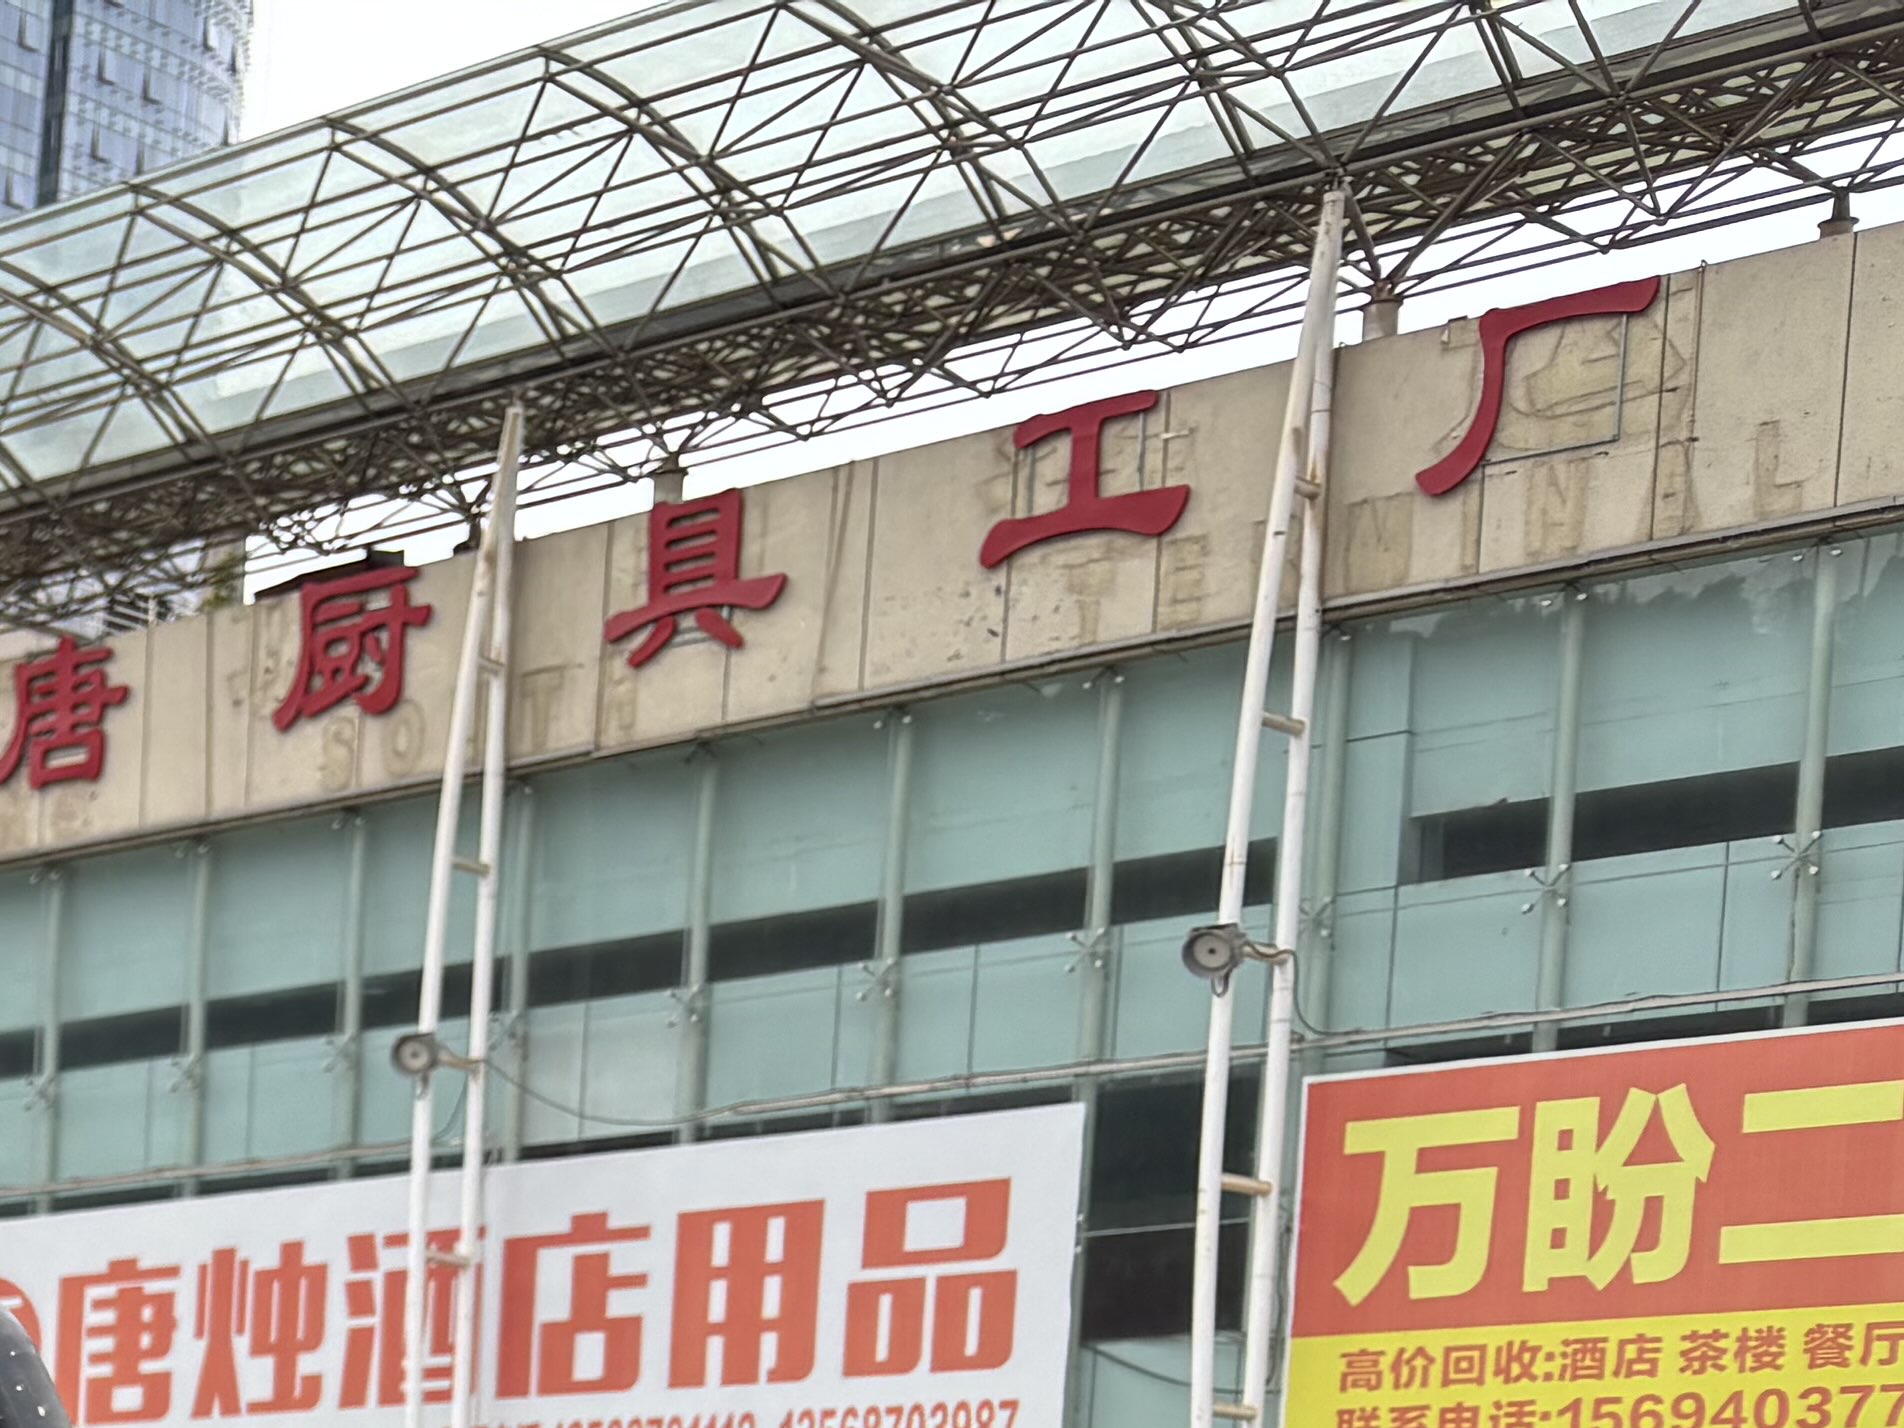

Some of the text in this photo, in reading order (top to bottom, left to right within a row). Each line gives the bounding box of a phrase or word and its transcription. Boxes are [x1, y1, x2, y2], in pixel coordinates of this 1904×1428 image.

[1332, 1080, 1904, 1307] 万盼二
[1338, 1319, 1904, 1394] 高价回收:酒店 茶楼 餐厅
